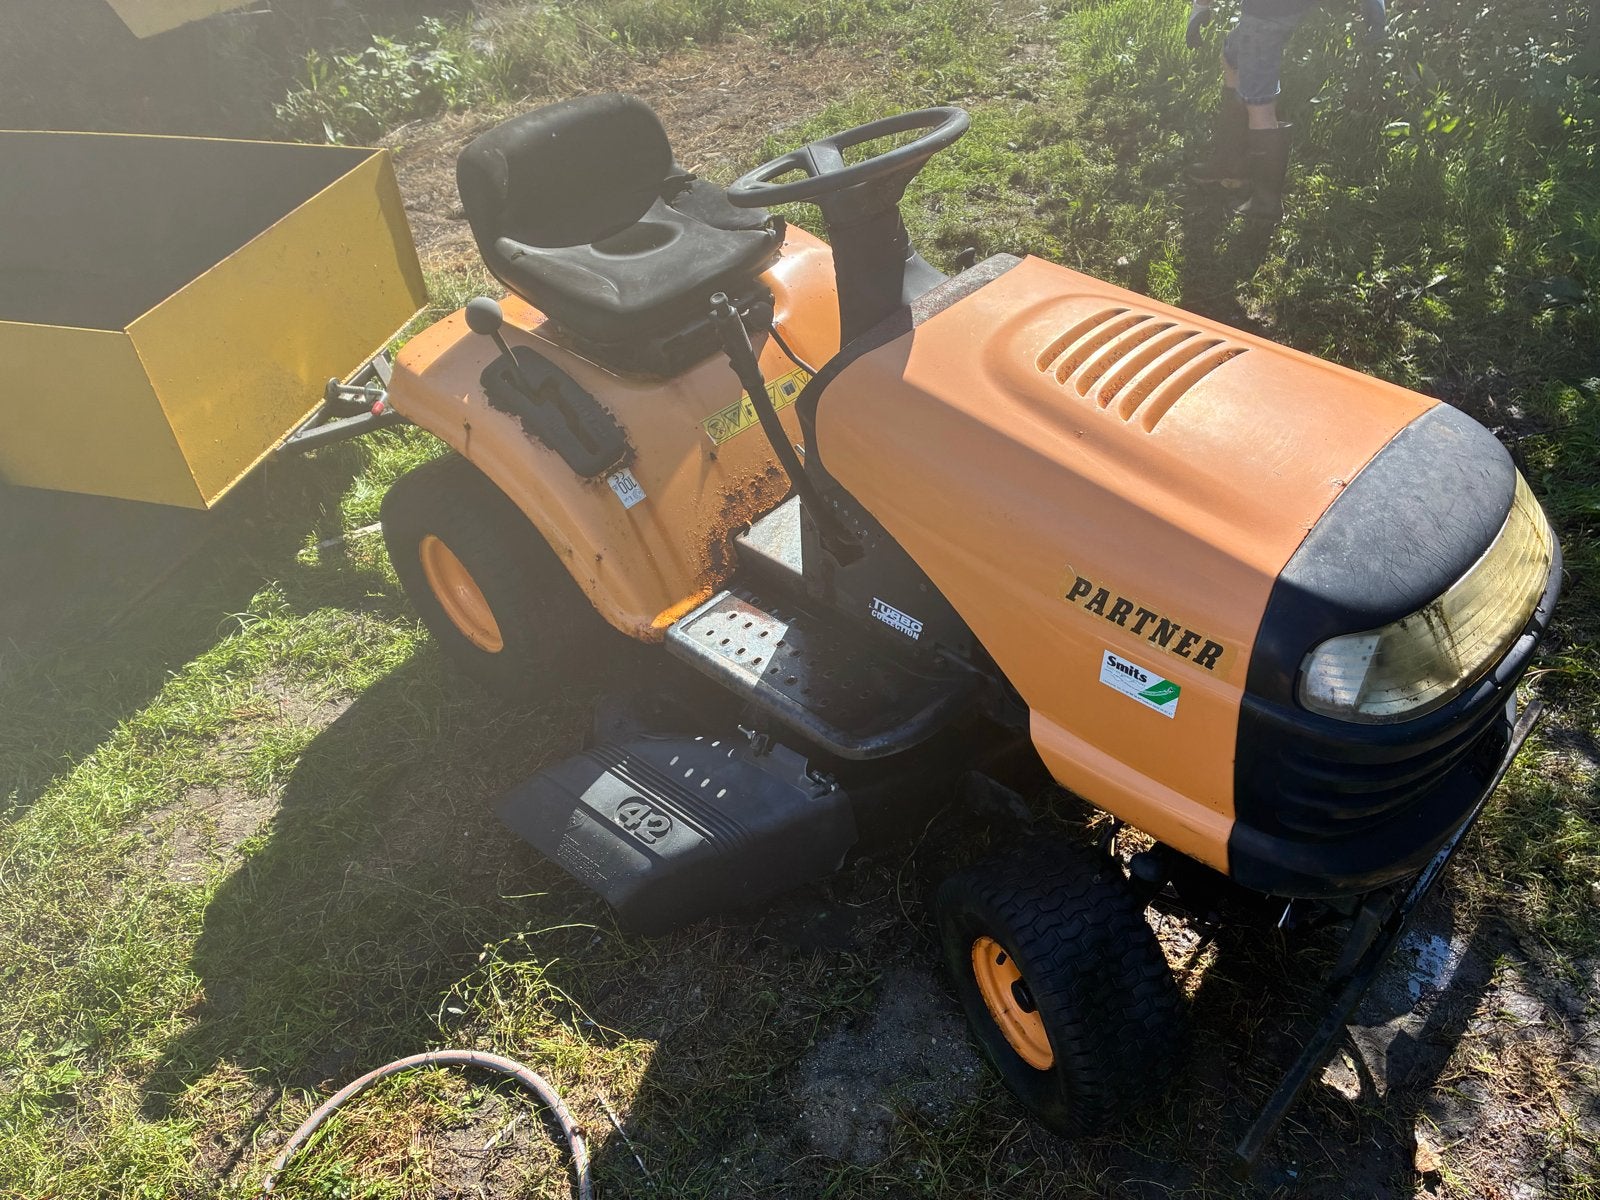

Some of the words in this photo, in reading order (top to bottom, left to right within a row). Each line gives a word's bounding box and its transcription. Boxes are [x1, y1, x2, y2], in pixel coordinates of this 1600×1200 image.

[618, 476, 638, 494] 100
[1065, 576, 1224, 670] PARTNER
[1106, 655, 1147, 683] Smits
[619, 804, 672, 845] 42
